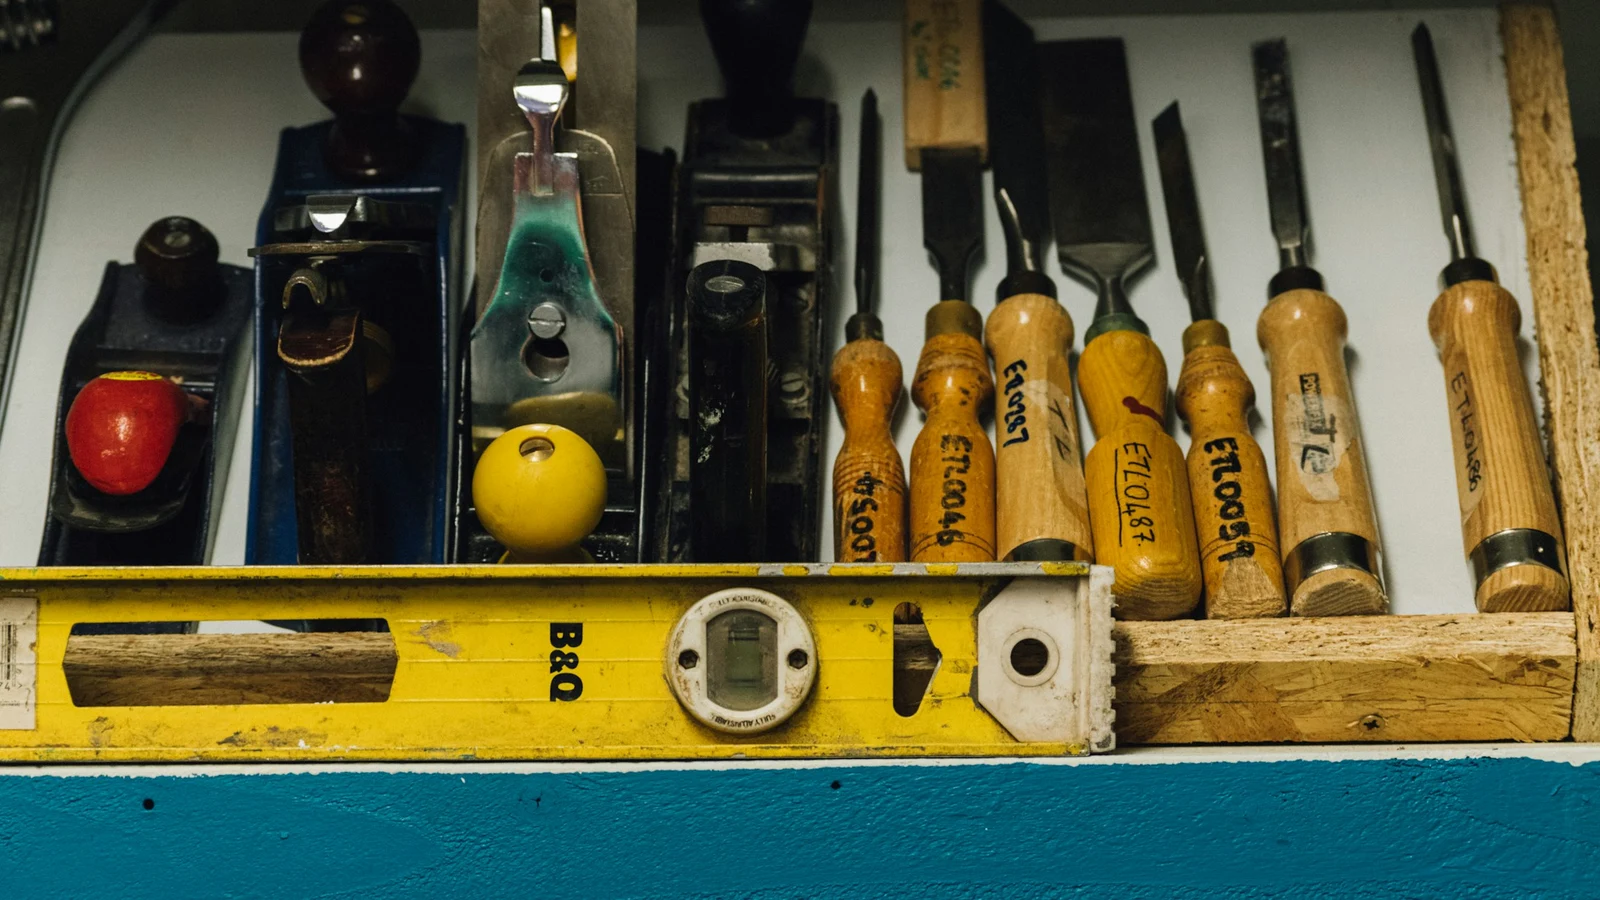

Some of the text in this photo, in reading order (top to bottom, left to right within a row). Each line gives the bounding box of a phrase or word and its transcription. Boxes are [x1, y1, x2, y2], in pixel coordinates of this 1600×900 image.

[937, 434, 973, 546] ETL0046
[1204, 437, 1255, 562] ETL0059
[549, 622, 583, 702] B&Q
[754, 714, 776, 727] FULLY
